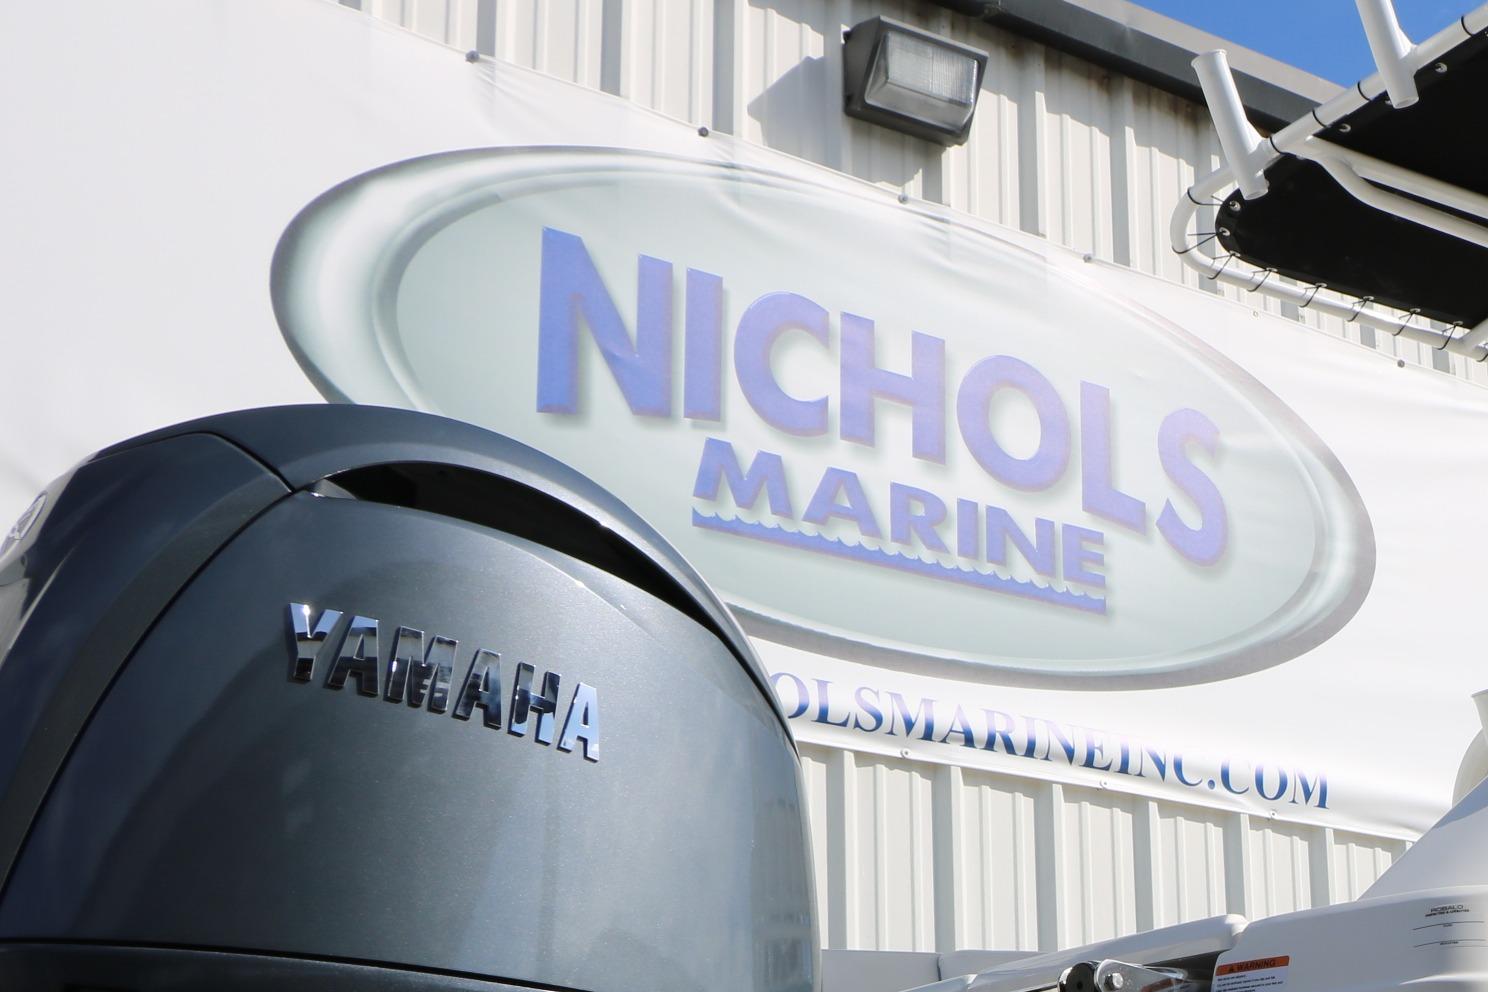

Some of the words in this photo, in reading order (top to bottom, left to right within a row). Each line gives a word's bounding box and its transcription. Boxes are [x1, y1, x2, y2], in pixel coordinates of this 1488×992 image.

[536, 226, 1230, 567] NICHOLS
[692, 436, 1106, 588] MARINE
[287, 602, 600, 764] YAMAHA
